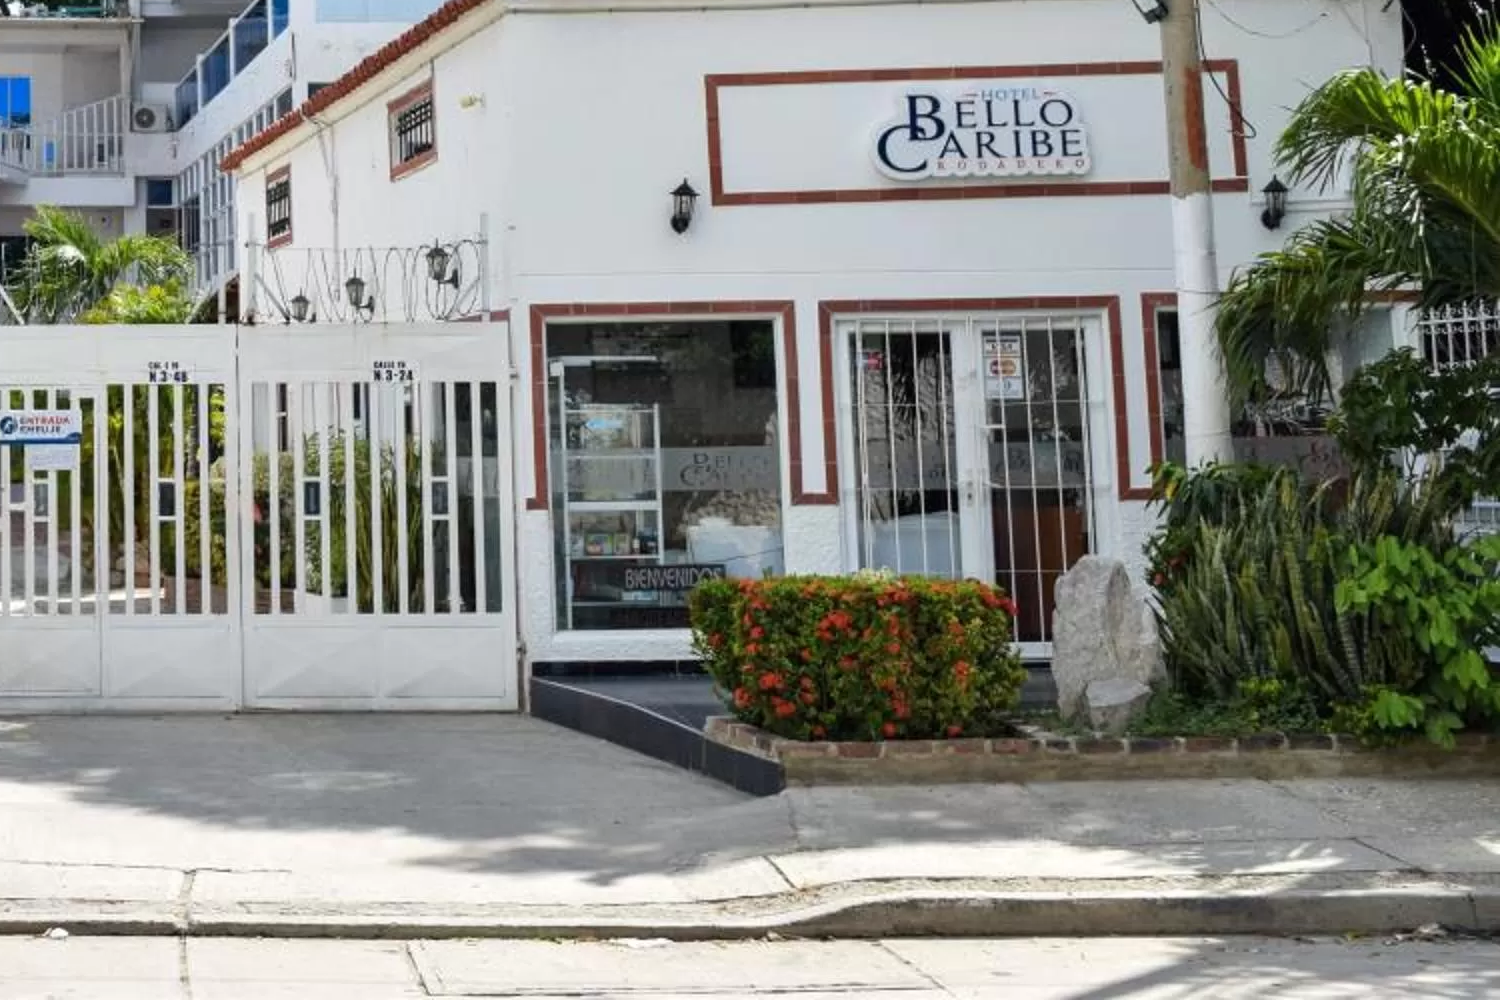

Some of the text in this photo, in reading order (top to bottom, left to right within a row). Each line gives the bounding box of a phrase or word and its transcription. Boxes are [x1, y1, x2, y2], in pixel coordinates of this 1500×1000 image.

[981, 87, 1041, 100] HOTEL
[906, 94, 1073, 141] BELLO
[877, 123, 1084, 173] CARIBE
[937, 158, 1085, 170] RODADERO
